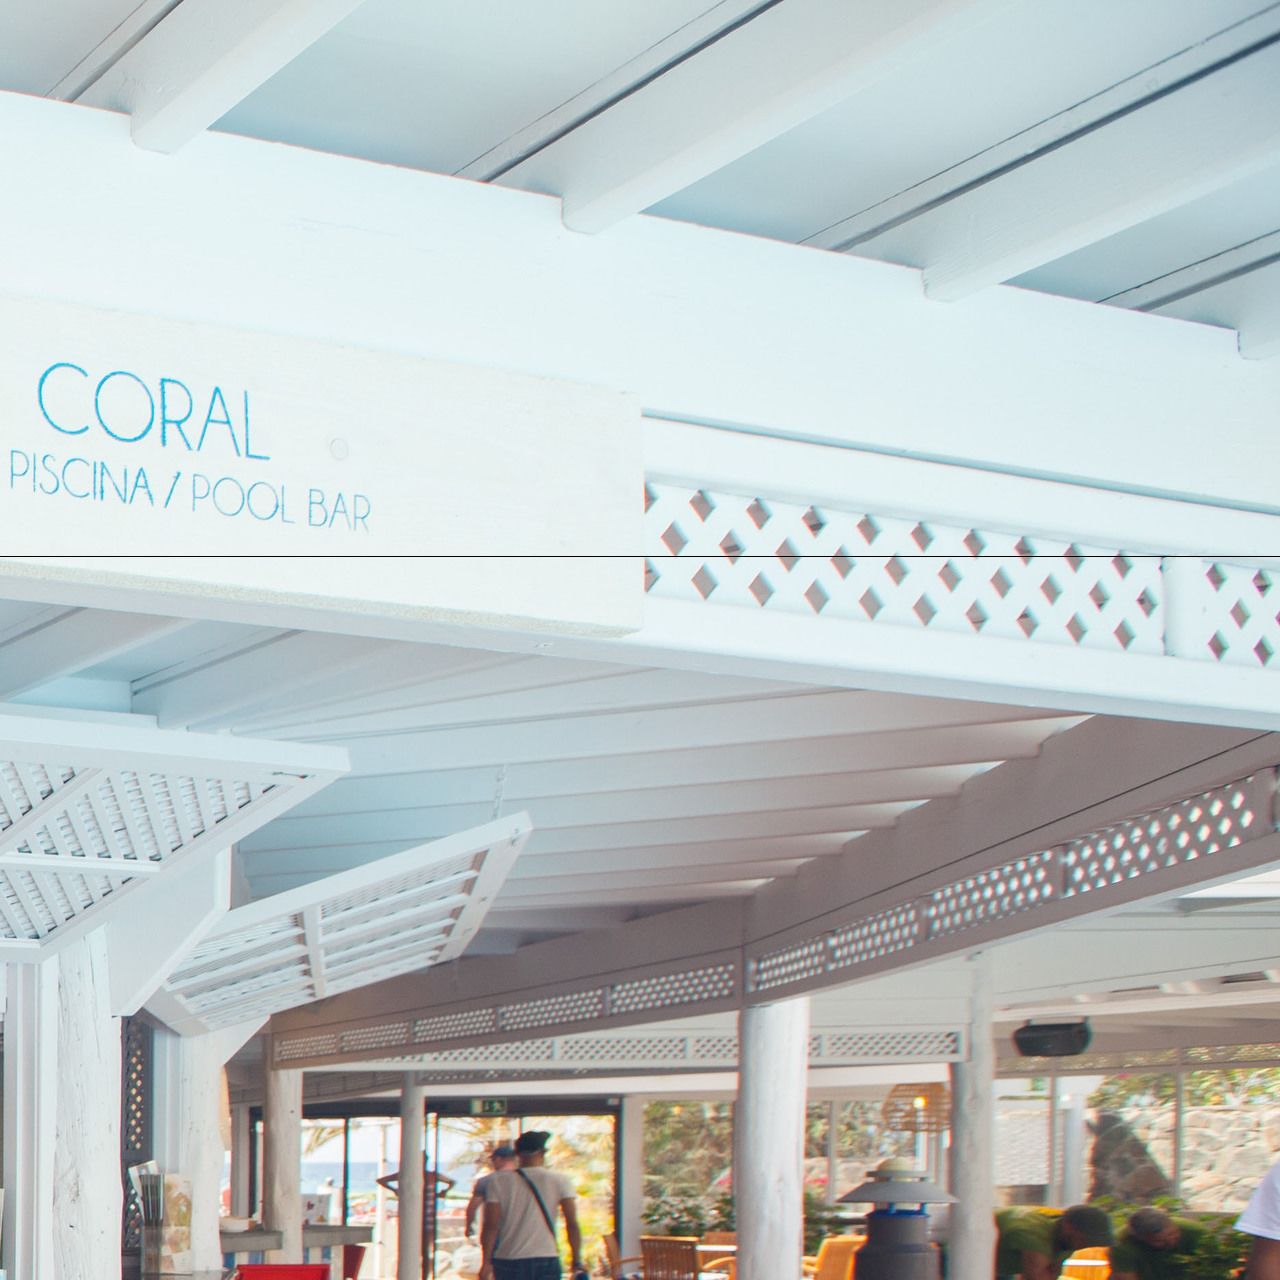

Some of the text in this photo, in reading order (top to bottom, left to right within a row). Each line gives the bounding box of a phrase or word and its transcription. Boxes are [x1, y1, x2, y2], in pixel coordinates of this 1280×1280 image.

[37, 360, 271, 462] CORAL
[9, 448, 154, 508] PISCINA
[192, 472, 296, 524] POOL
[308, 487, 372, 532] BAR
